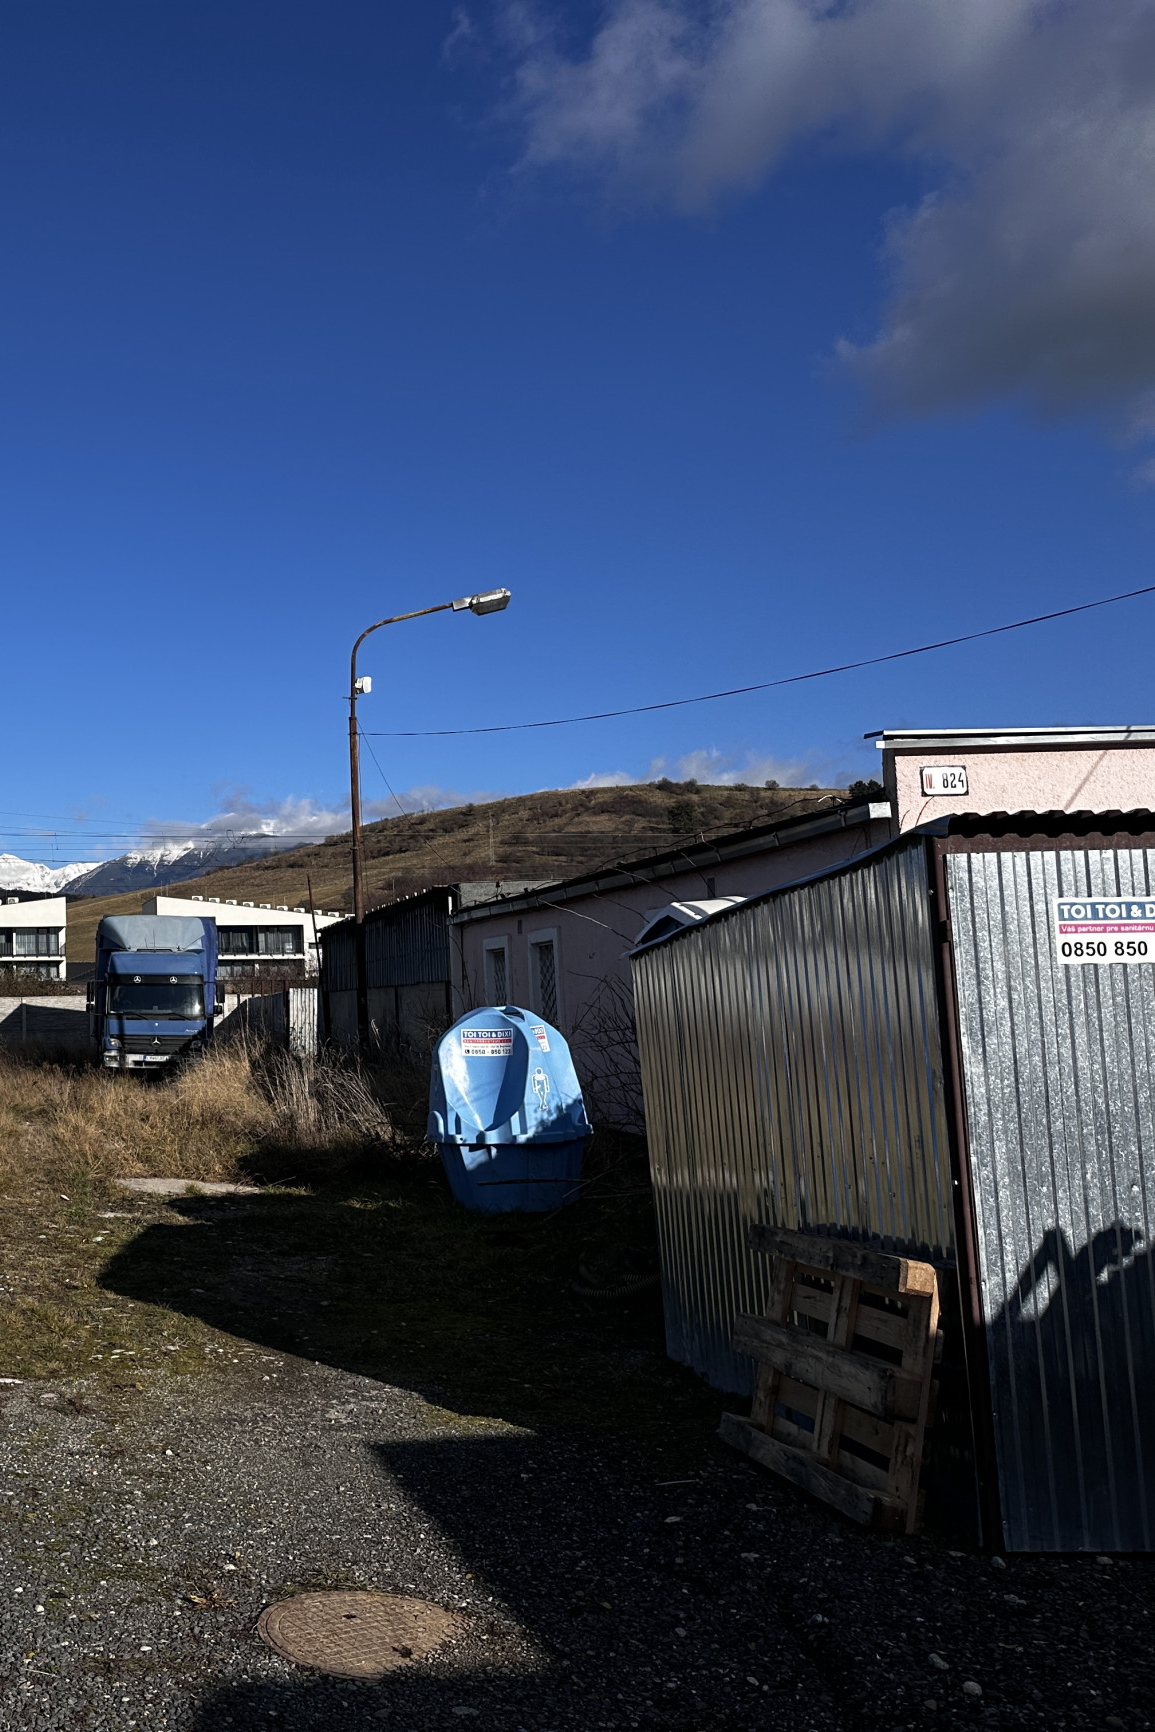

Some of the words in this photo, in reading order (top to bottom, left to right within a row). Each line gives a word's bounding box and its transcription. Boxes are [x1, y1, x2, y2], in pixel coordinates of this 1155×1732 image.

[942, 772, 965, 789] 824
[1060, 904, 1092, 919] TOI
[1095, 904, 1127, 919] TOI
[1130, 904, 1142, 918] &
[1077, 925, 1104, 934] partner
[1106, 925, 1119, 933] pre
[1120, 924, 1154, 932] sanitárnu
[1061, 942, 1107, 957] 0850
[1114, 941, 1148, 956] 850
